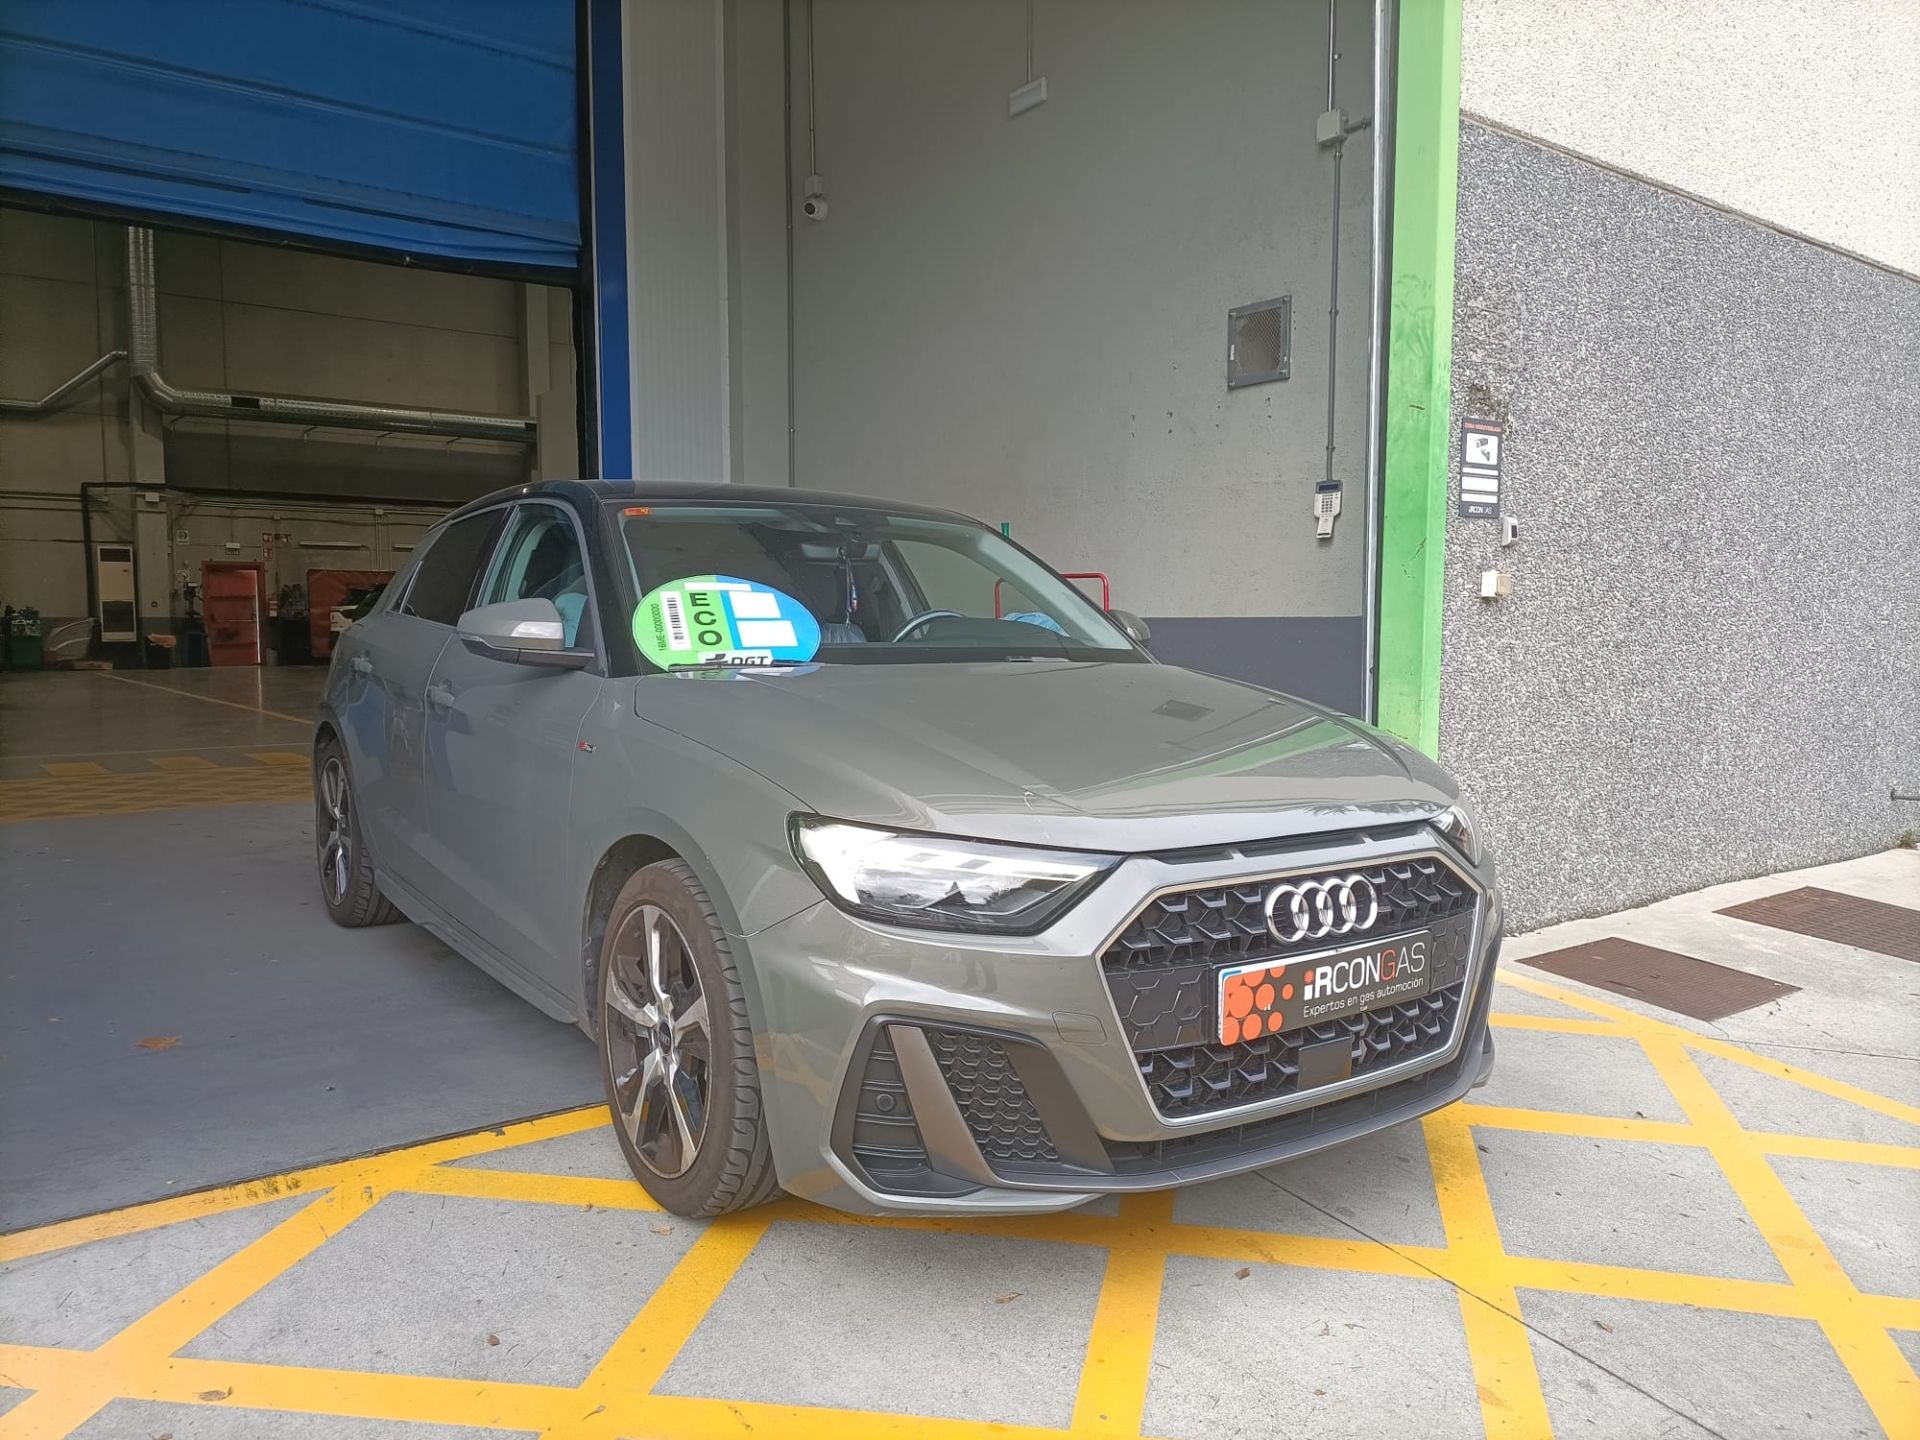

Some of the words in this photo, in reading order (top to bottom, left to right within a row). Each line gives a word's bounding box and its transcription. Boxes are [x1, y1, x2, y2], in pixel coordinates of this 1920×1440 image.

[689, 592, 723, 646] ECO
[731, 655, 769, 666] DGT
[1303, 999, 1345, 1018] Expertos
[1347, 995, 1358, 1006] en
[1359, 991, 1375, 1006] gas
[1376, 976, 1424, 998] automoción
